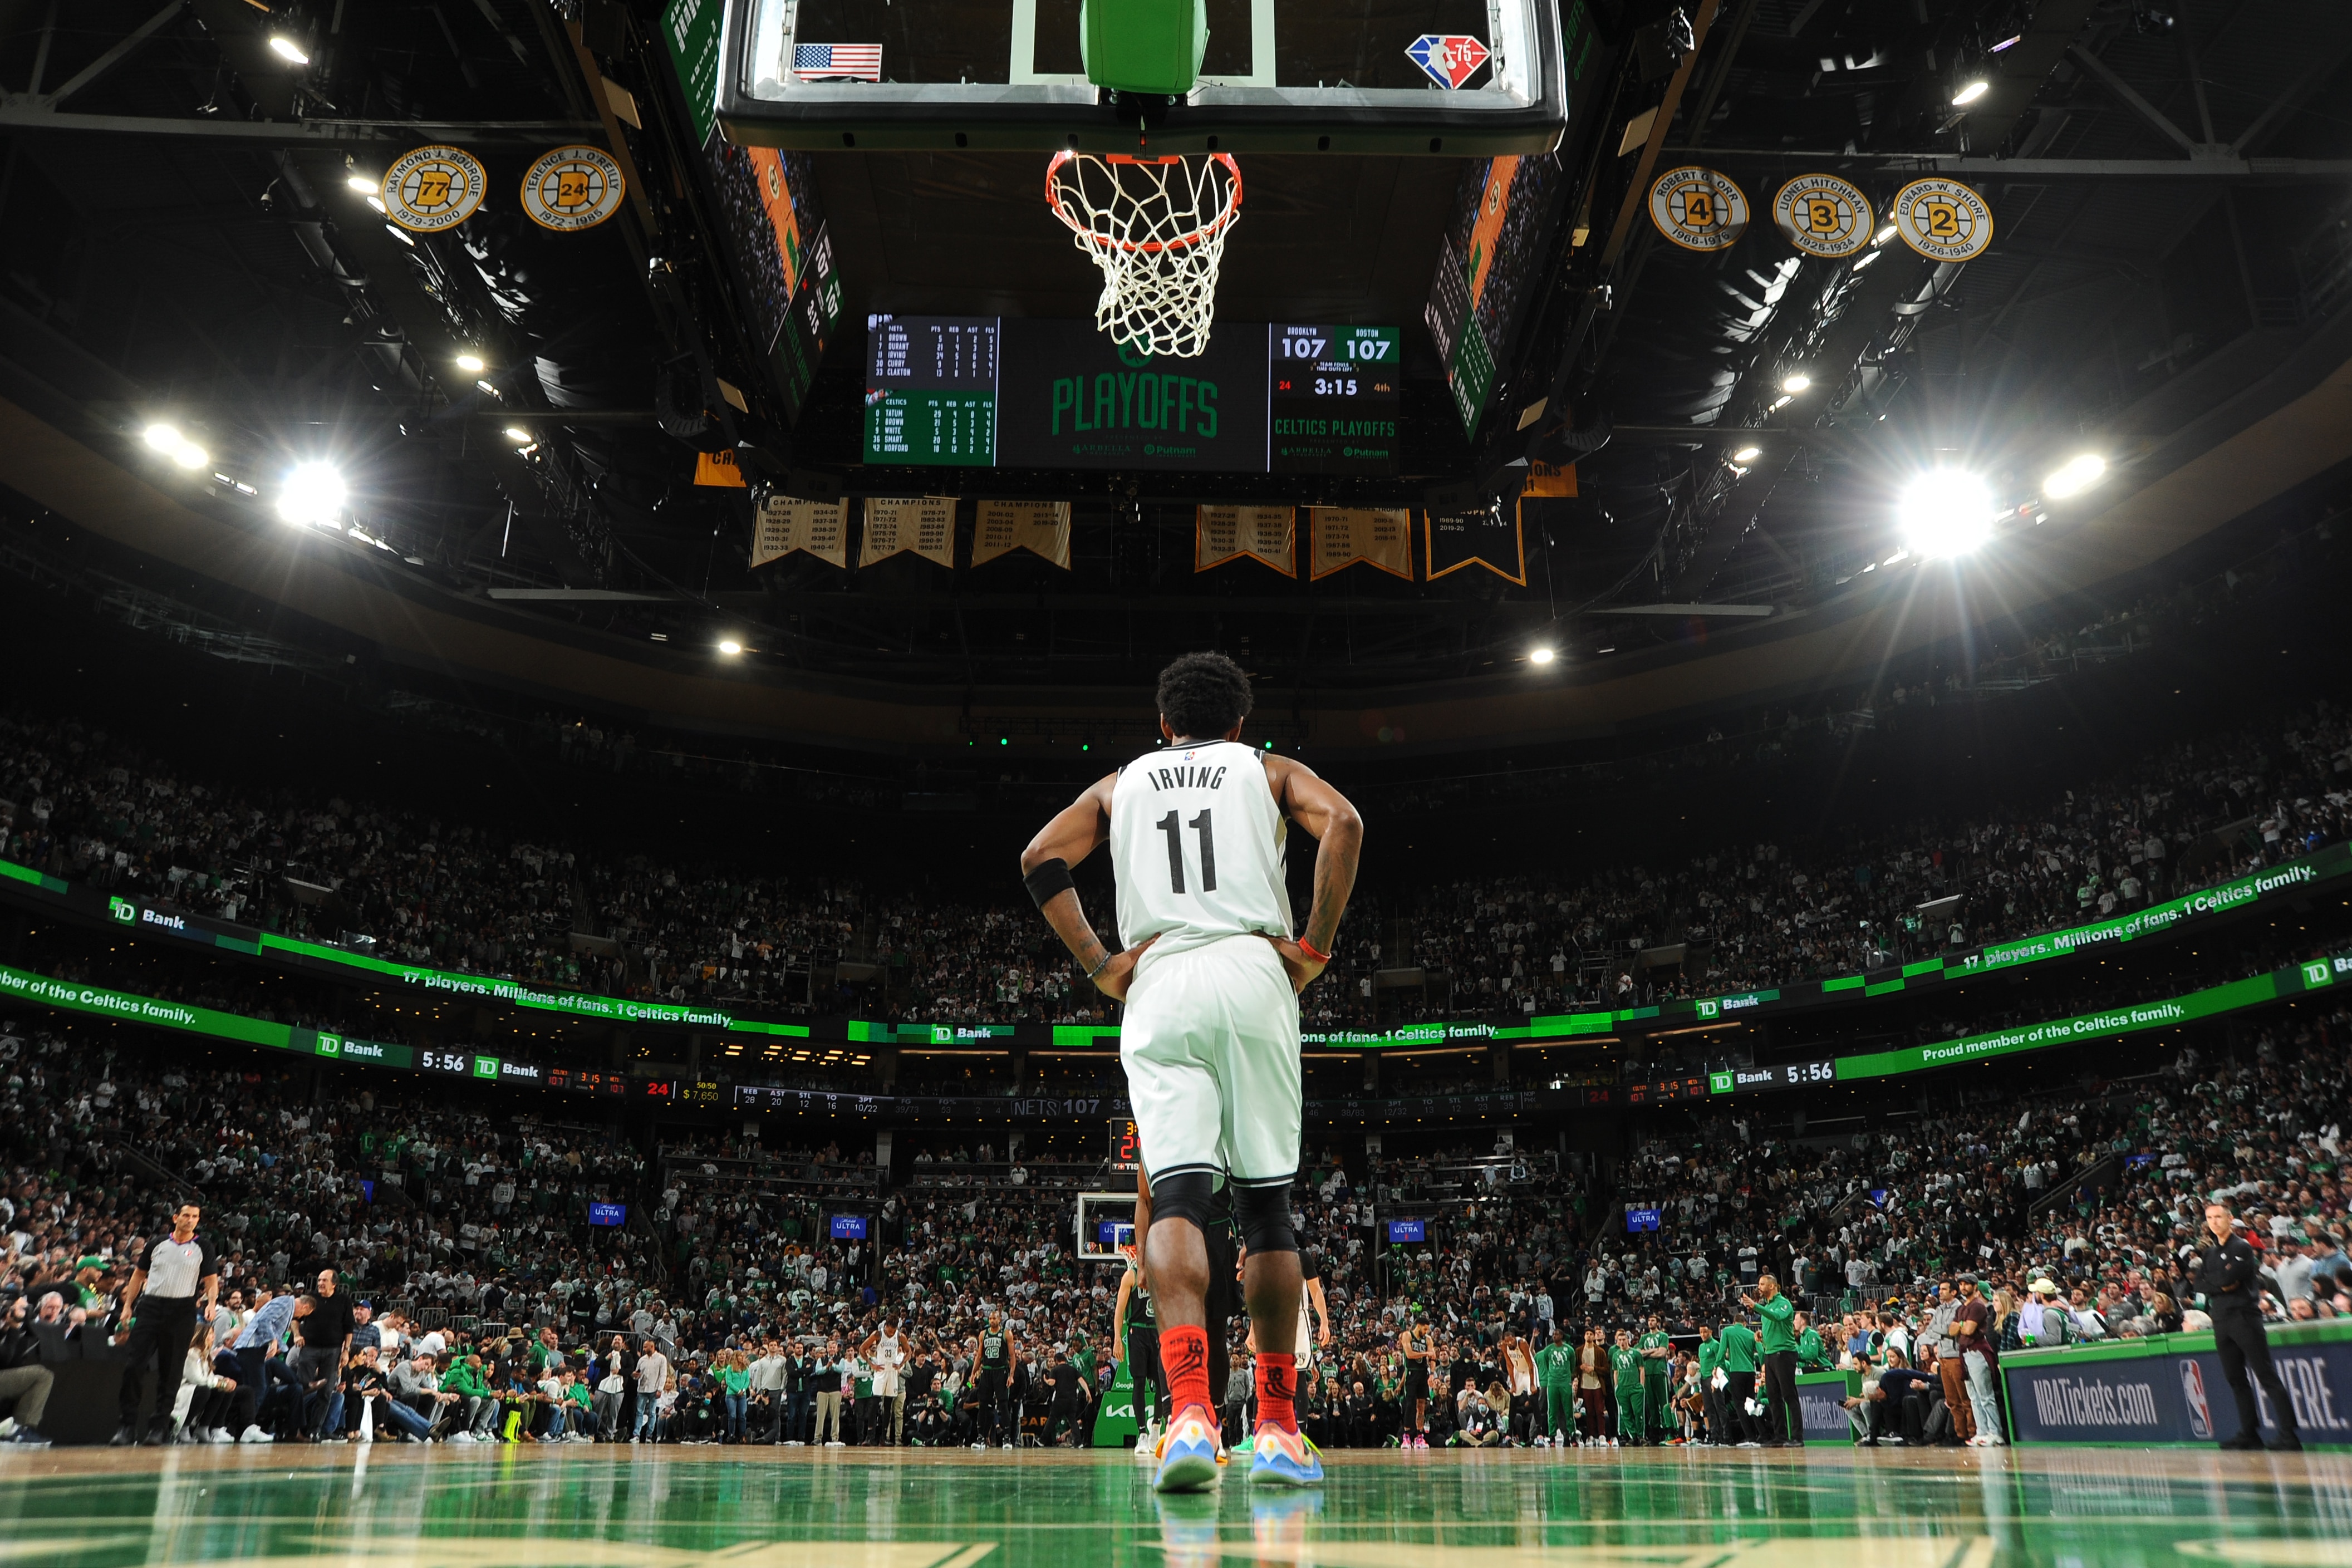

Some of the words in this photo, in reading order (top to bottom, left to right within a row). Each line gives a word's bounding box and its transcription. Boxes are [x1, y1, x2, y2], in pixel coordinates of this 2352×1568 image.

[1455, 44, 1472, 62] 75
[387, 151, 431, 193] RAYMOND
[435, 150, 444, 159] J.
[449, 153, 480, 197] BOURQUE
[527, 152, 566, 191] TERENCE
[573, 150, 582, 159] J.
[587, 152, 618, 190] O'REILLY
[423, 181, 448, 196] 77
[561, 183, 585, 196] 24
[1657, 171, 1696, 197] ROBERT
[1701, 173, 1712, 183] G.
[1717, 180, 1738, 201] ORR
[1779, 181, 1808, 210] LIONEL
[1810, 179, 1865, 214] HITCHMAN
[1899, 184, 1932, 215] EDWARD
[1937, 183, 1950, 192] W.
[1955, 189, 1985, 220] SHORE
[396, 209, 460, 226] 1979-2000
[1690, 199, 1709, 220] 4
[1813, 205, 1833, 227] 3
[1933, 209, 1953, 230] 2
[1672, 228, 1730, 245] 1966-1976
[1799, 236, 1854, 252] 1925-1934
[1918, 239, 1973, 256] 1926-1940
[1287, 326, 1317, 336] BROOKLYN
[1356, 328, 1379, 337] BOSTON
[1282, 338, 1326, 358] 107
[1347, 340, 1391, 360] 107
[1279, 381, 1291, 390] 24
[1314, 378, 1357, 395] 3:15
[1374, 383, 1390, 392] 4th
[1052, 372, 1217, 438] PLAYOFFS
[1275, 419, 1326, 435] CELTICS
[1333, 420, 1394, 437] PLAYOFFS
[885, 444, 908, 452] HORFORD
[1157, 445, 1196, 454] Putnam
[1148, 766, 1226, 792] IRVING
[1156, 808, 1217, 894] 11
[112, 902, 135, 921] TD
[143, 909, 185, 930] Bank
[1963, 955, 1978, 970] 17
[1985, 943, 2051, 967] players.
[2054, 925, 2123, 950] Millions
[2125, 918, 2142, 933] of
[2143, 908, 2182, 928] fans.
[2184, 901, 2191, 915] 1
[2194, 885, 2252, 911] Celtics
[2255, 865, 2317, 892] family.
[2304, 964, 2328, 984] TD
[30, 981, 47, 993] of
[49, 985, 77, 1001] the
[80, 990, 139, 1012] Celtics
[143, 1002, 195, 1024] family.
[403, 971, 420, 984] 17
[425, 975, 490, 995] players.
[493, 984, 555, 1005] Millions
[558, 996, 575, 1007] of
[576, 997, 612, 1013] fans.
[616, 1004, 623, 1014] 1
[626, 1005, 679, 1021] Celtics
[682, 1010, 733, 1028] family.
[1701, 1001, 1716, 1016] TD
[1723, 995, 1759, 1010] Bank
[932, 1027, 951, 1040] TD
[957, 1027, 991, 1039] Bank
[1329, 1033, 1343, 1043] of
[1346, 1033, 1382, 1044] fans.
[1385, 1030, 1392, 1041] 1
[1395, 1028, 1446, 1040] Celtics
[1448, 1024, 1499, 1038] family.
[1922, 1043, 1963, 1061] Proud
[1966, 1033, 2025, 1053] member
[2028, 1030, 2043, 1042] of
[2046, 1025, 2070, 1039] the
[2073, 1017, 2128, 1034] Celtics
[2131, 1004, 2185, 1024] family.
[320, 1036, 338, 1053] TD
[344, 1041, 383, 1057] Bank
[422, 1051, 464, 1072] 5:56
[477, 1059, 496, 1075] TD
[502, 1063, 539, 1078] Bank
[1712, 1075, 1731, 1090] TD
[1737, 1070, 1772, 1084] Bank
[1787, 1062, 1833, 1083] 5:56
[647, 1083, 668, 1095] 24
[683, 1089, 690, 1099] $
[693, 1090, 719, 1101] 7,650
[1590, 1091, 1609, 1103] 24
[855, 1104, 877, 1113] 10/22
[1014, 1099, 1057, 1115] NETS
[1063, 1099, 1099, 1113] 107
[595, 1208, 619, 1217] ULTRA
[885, 1349, 892, 1358] 33
[985, 1348, 1000, 1358] 42
[2033, 1377, 2158, 1426] NBATickets.com
